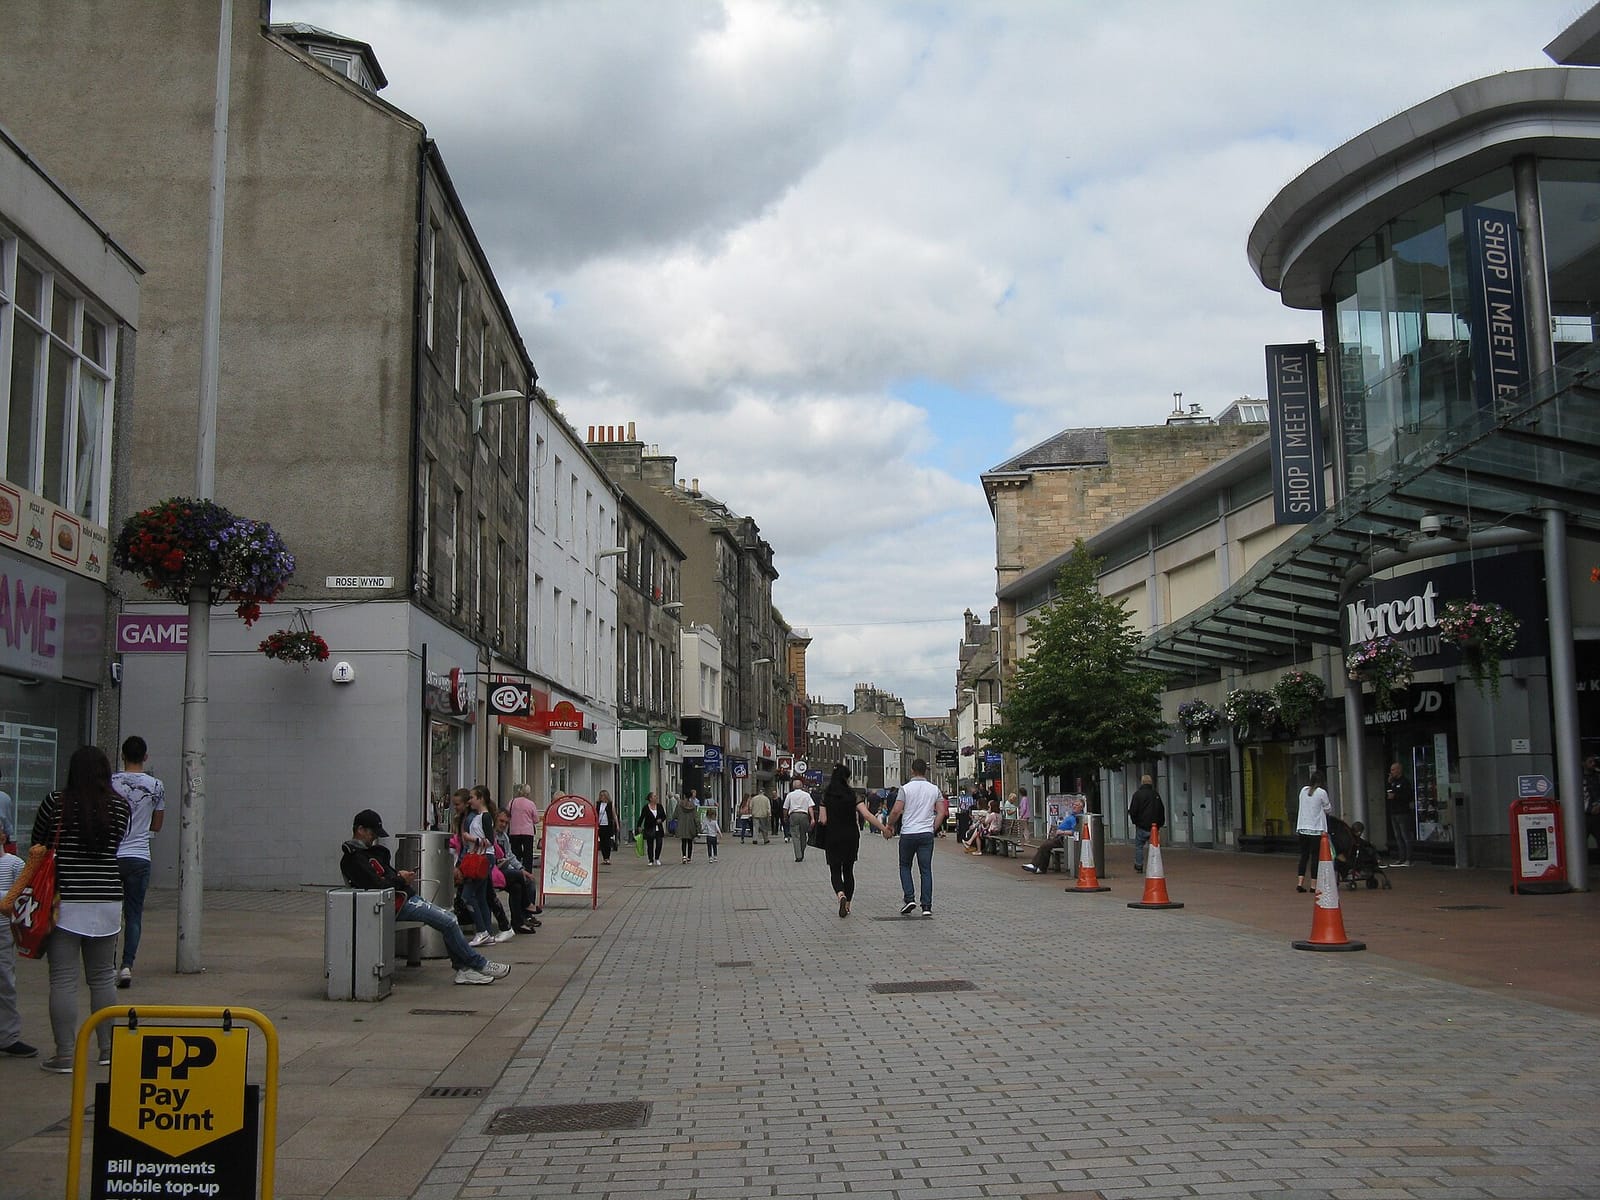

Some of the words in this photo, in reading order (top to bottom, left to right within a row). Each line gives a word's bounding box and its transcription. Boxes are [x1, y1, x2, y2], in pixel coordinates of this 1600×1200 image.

[1484, 219, 1508, 280] SHOP
[1491, 301, 1518, 361] MEET
[1281, 354, 1302, 385] EAT
[1284, 402, 1307, 449] MEET
[1290, 467, 1310, 513] SHOP
[335, 577, 358, 587] ROSE
[360, 577, 385, 587] WYND
[1346, 580, 1440, 646] Mercat
[121, 623, 188, 645] GAME
[1413, 691, 1442, 713] JD
[139, 1083, 190, 1112] Pay
[138, 1107, 214, 1131] Point
[107, 1160, 132, 1173] Bill
[136, 1161, 216, 1177] payments
[106, 1179, 162, 1193] Mobile
[165, 1180, 220, 1197] top-up
